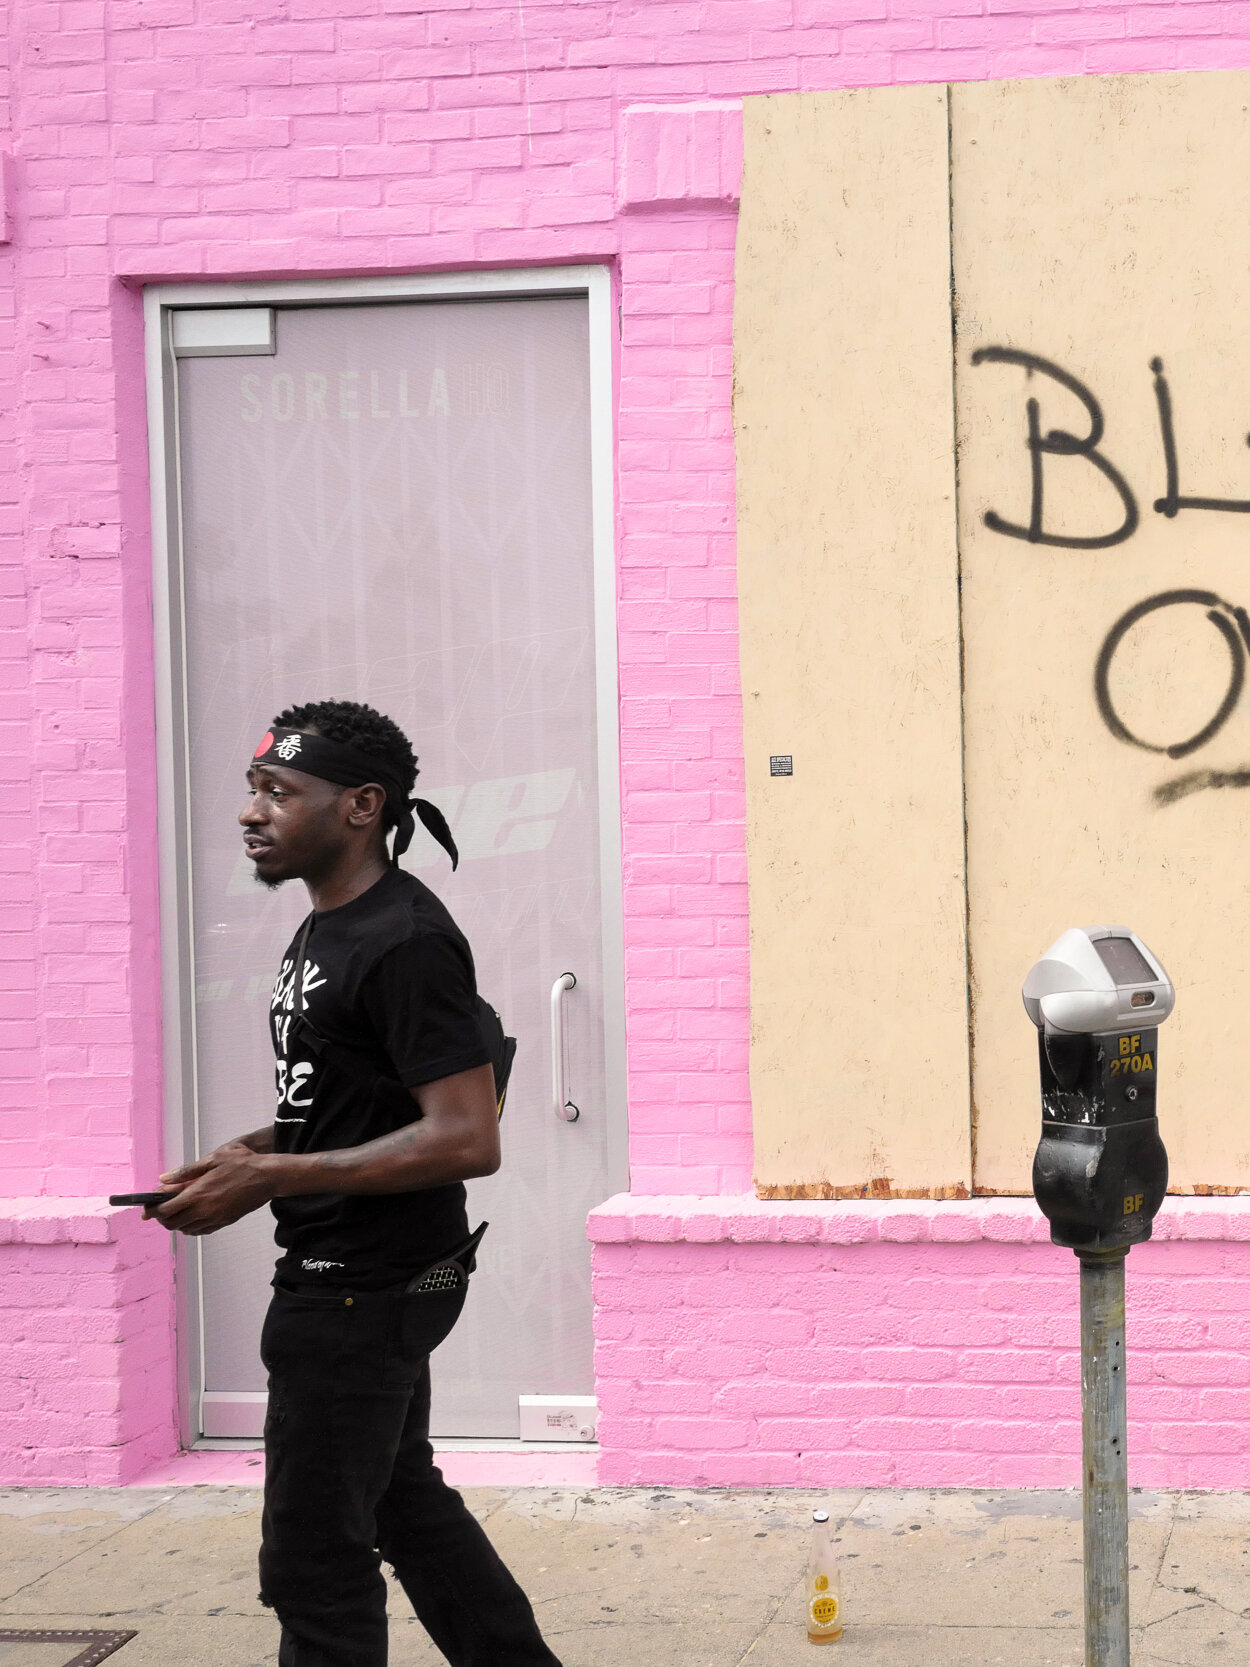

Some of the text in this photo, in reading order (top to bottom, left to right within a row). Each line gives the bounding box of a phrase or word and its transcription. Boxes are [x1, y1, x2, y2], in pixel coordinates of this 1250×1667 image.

[239, 362, 512, 423] SORELLA HQ
[274, 734, 302, 760] 番
[1119, 1034, 1141, 1056] BF
[1110, 1053, 1153, 1078] 270A
[1123, 1193, 1145, 1215] BF
